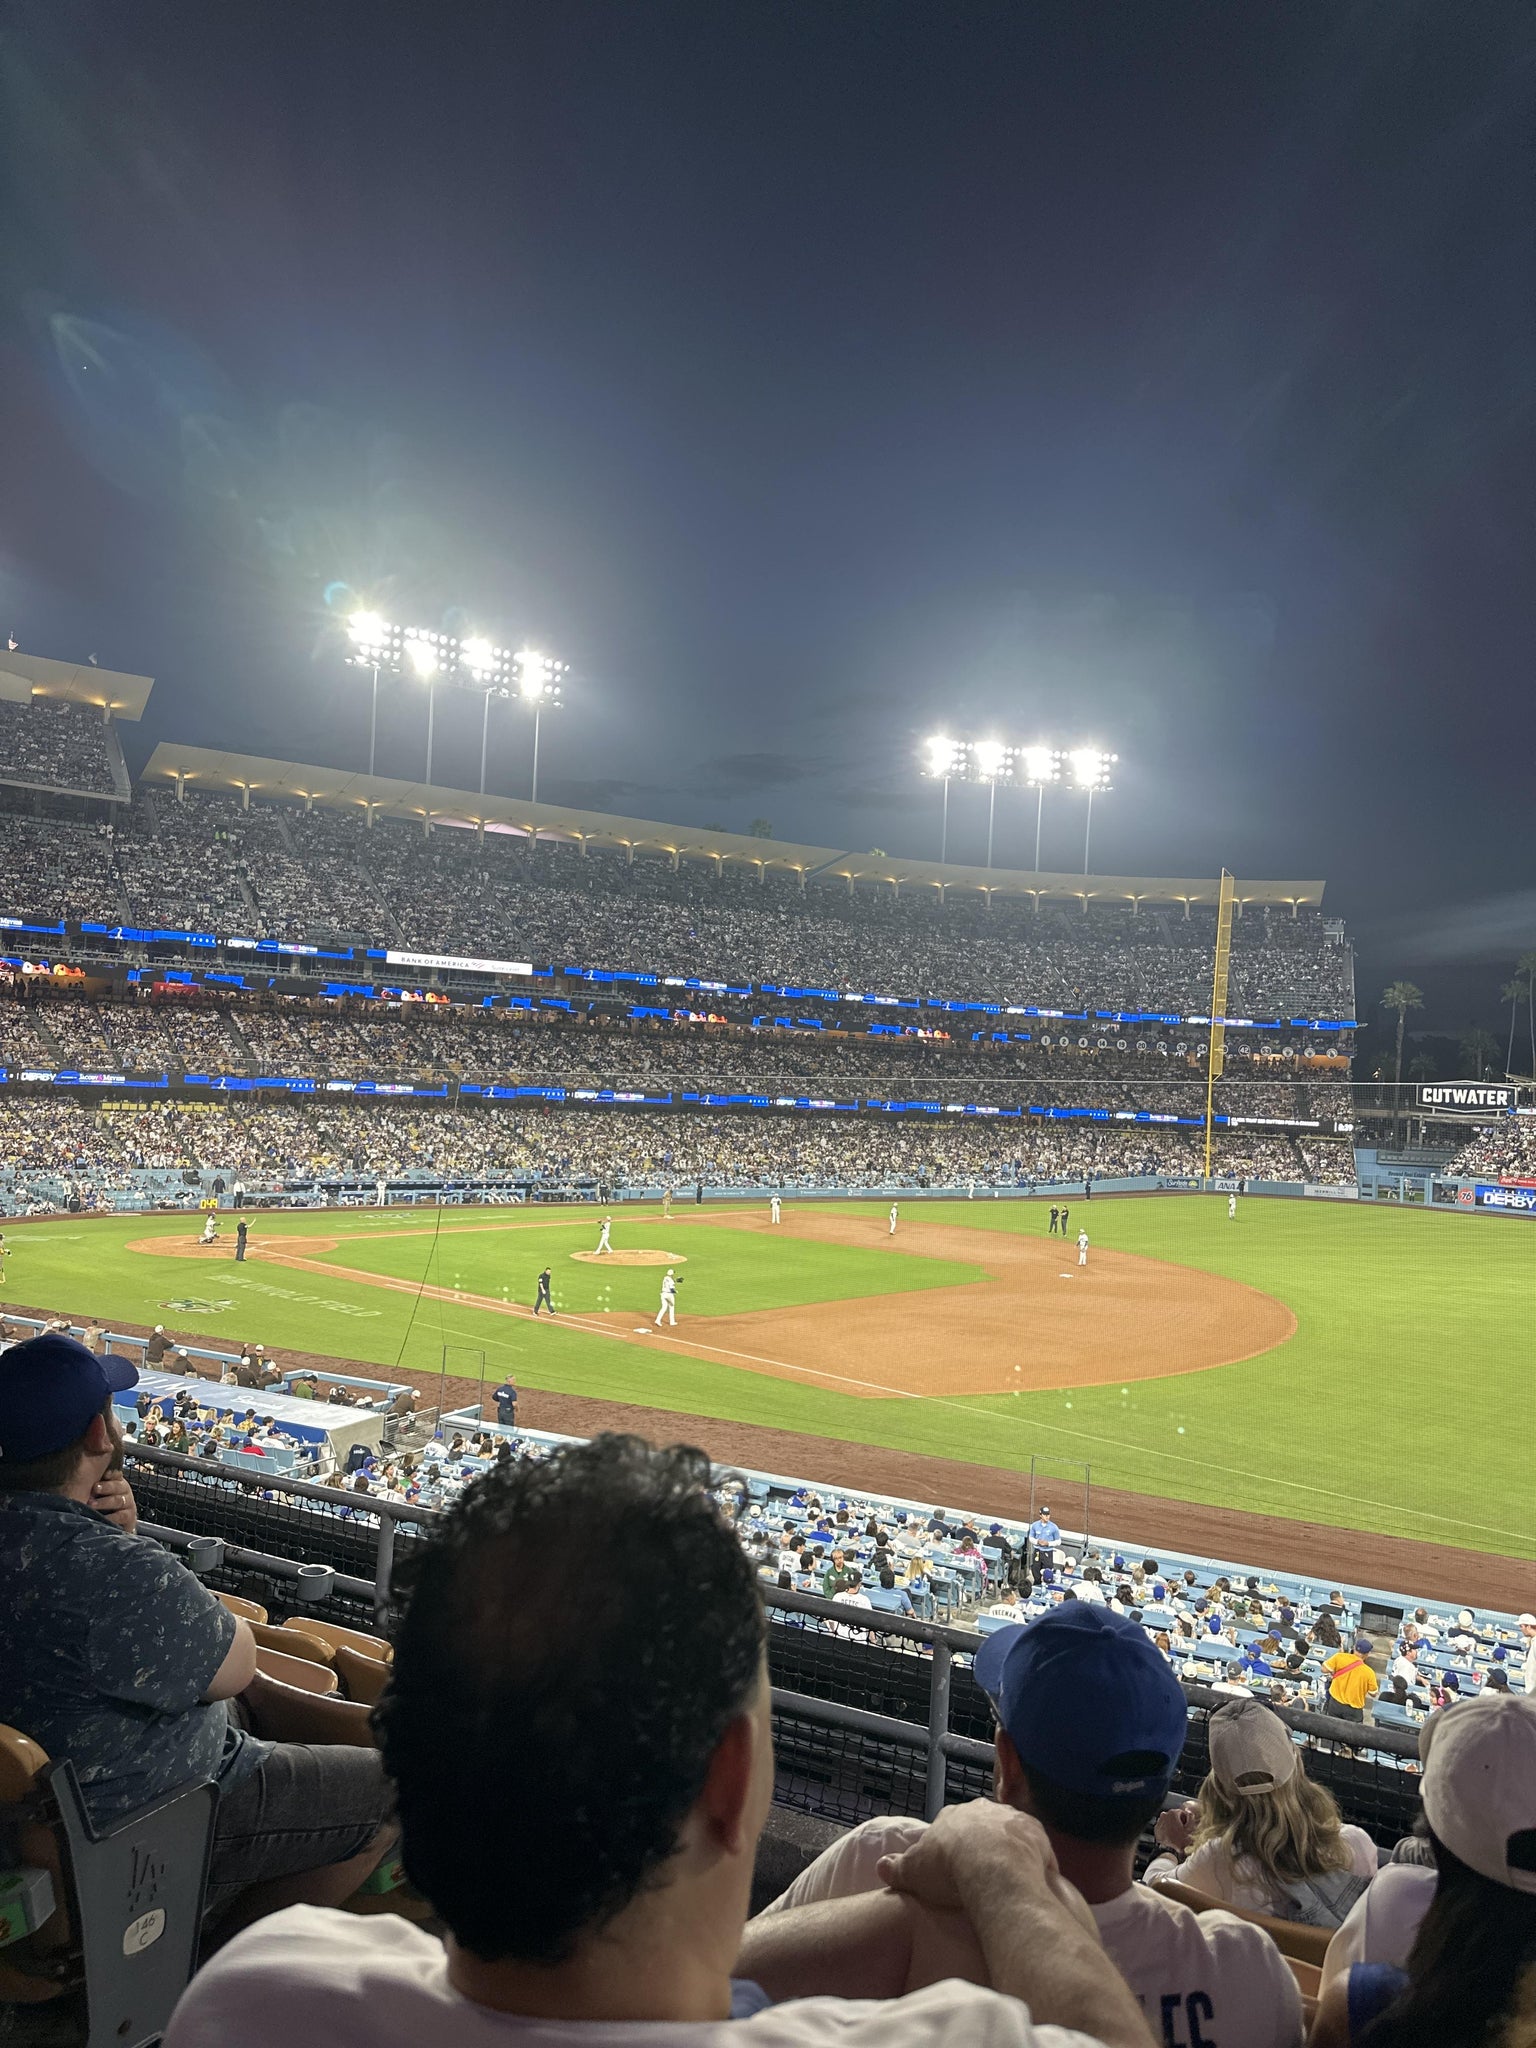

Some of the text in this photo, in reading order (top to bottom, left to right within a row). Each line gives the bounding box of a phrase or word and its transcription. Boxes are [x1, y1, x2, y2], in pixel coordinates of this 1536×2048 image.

[436, 960, 470, 968] AMERICA
[1422, 1088, 1508, 1106] CUTWATER
[1484, 1192, 1536, 1209] DERBY
[308, 1300, 382, 1317] FIELD
[992, 1610, 1016, 1619] FREEMAN
[140, 1932, 150, 1946] C
